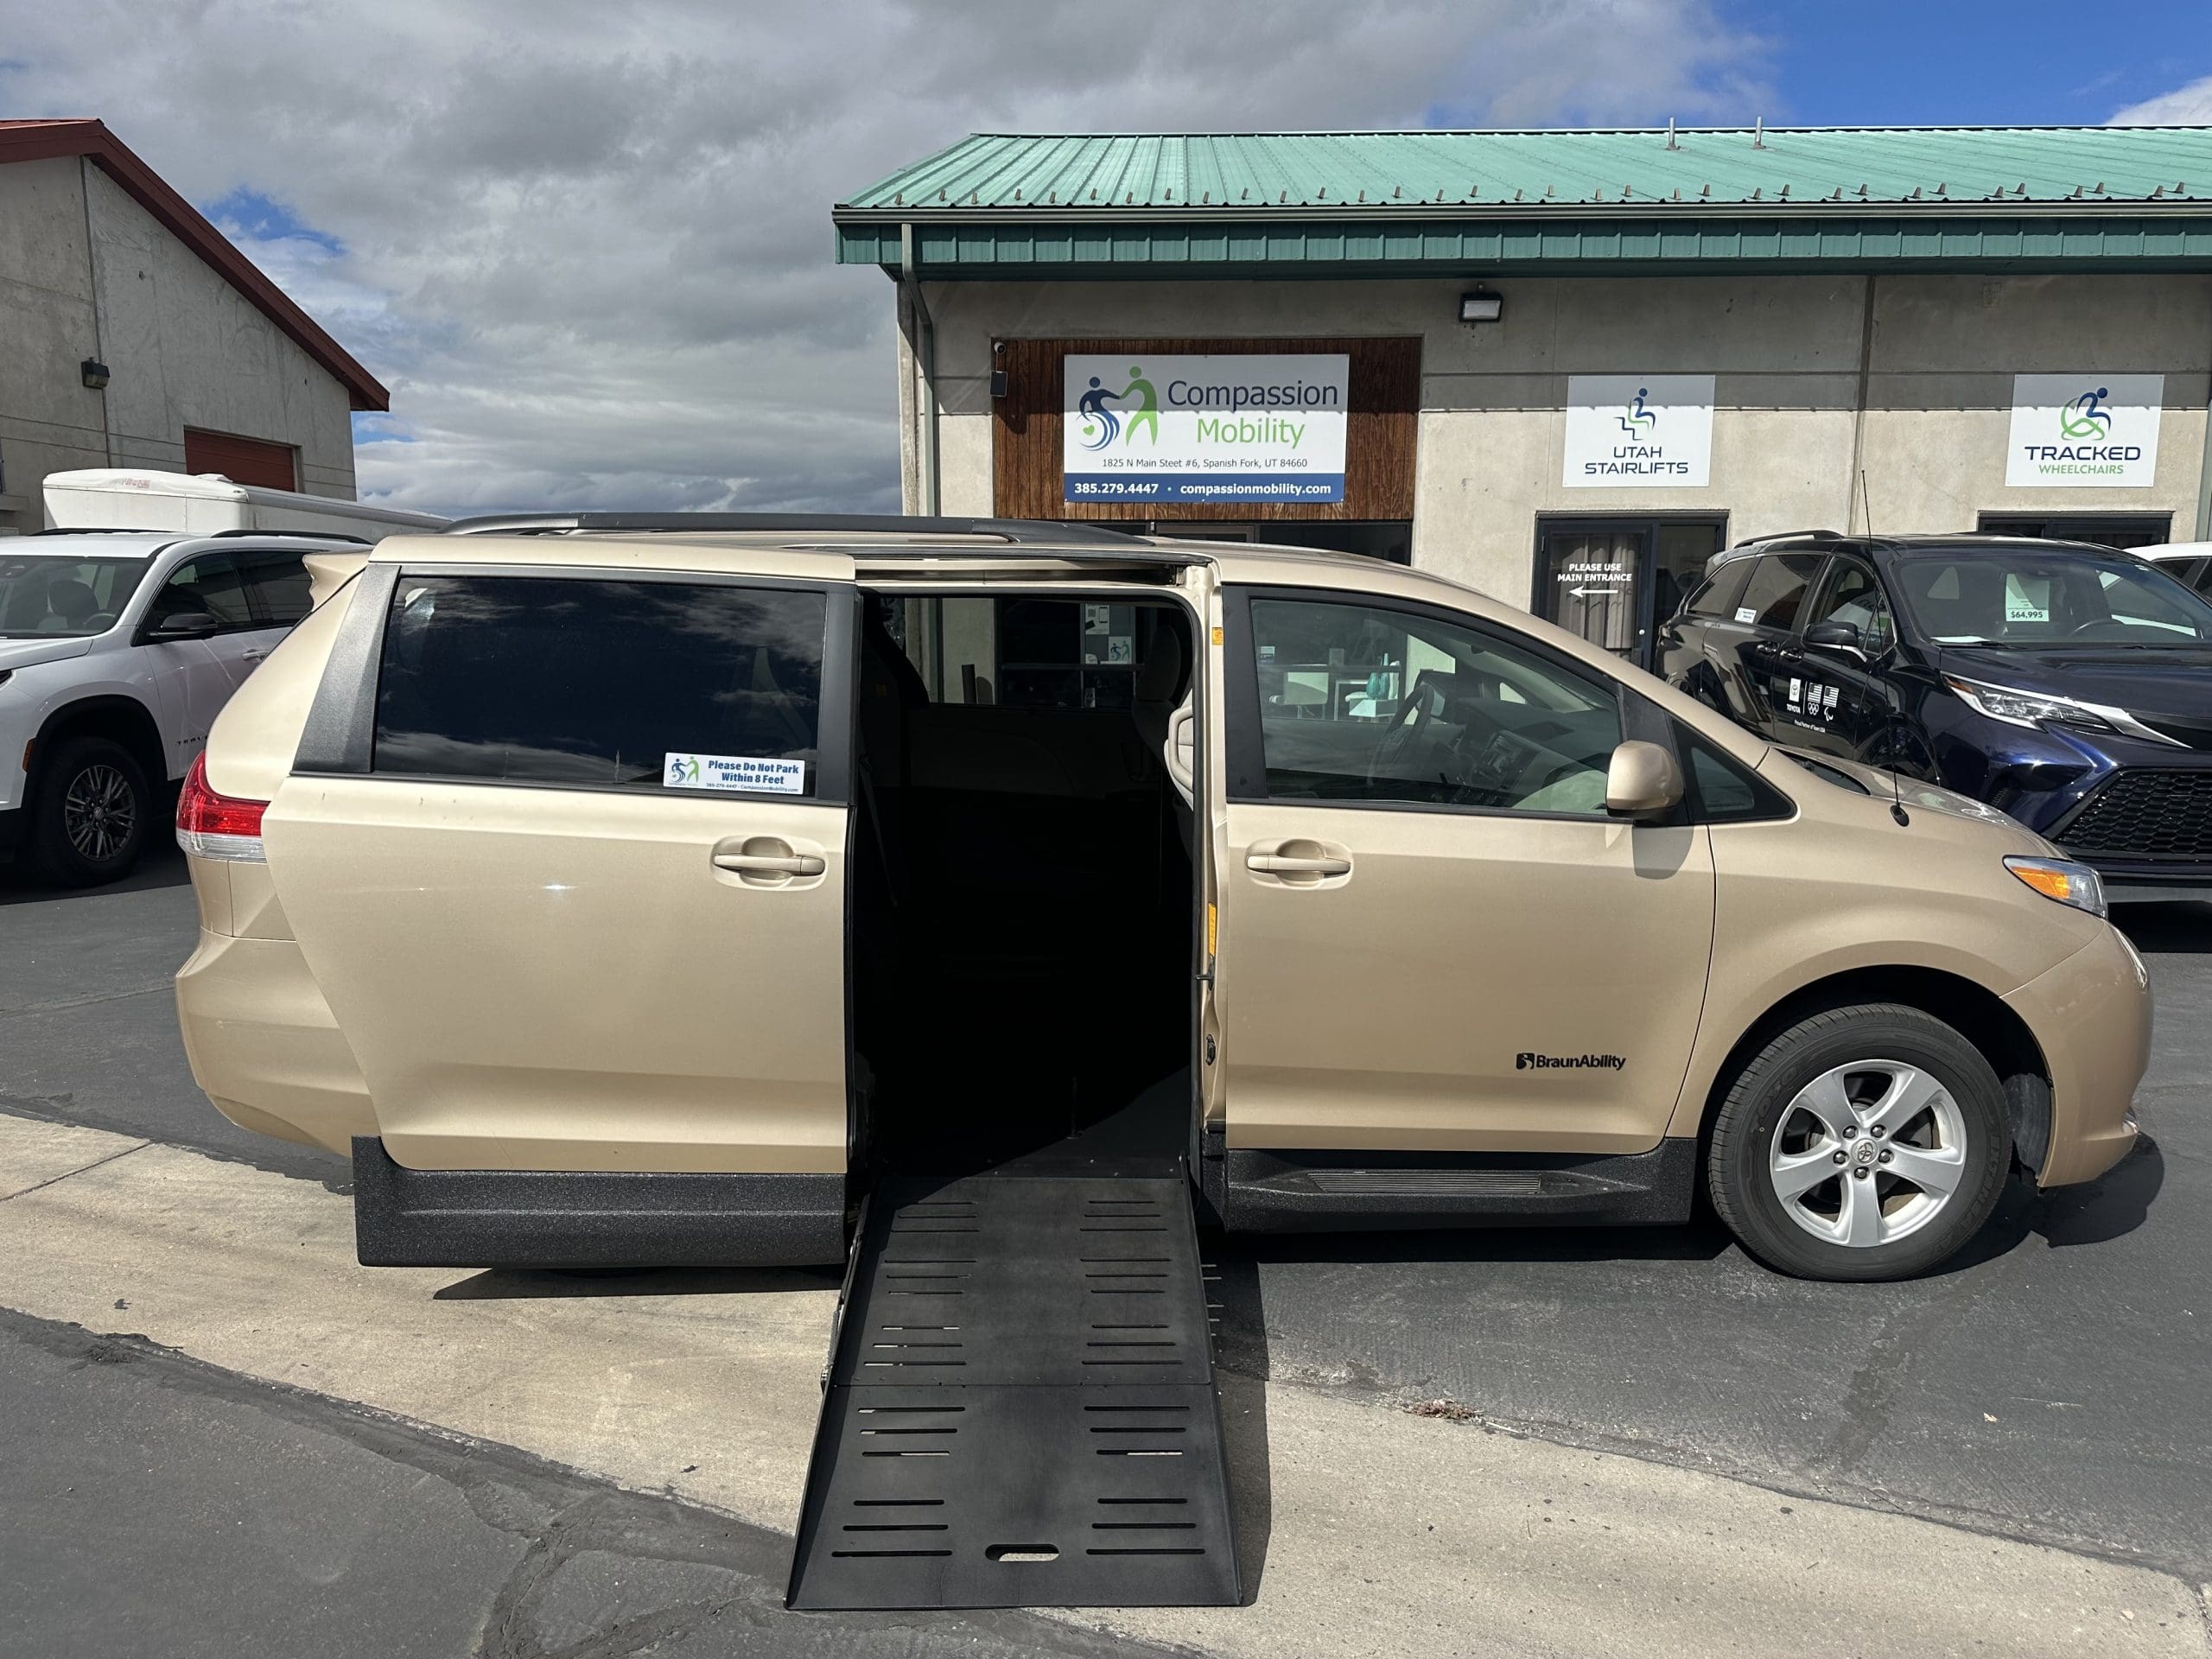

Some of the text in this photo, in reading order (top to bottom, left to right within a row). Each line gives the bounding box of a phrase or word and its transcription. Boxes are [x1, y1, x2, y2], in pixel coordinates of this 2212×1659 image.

[1168, 380, 1338, 411] Compassion
[1198, 418, 1306, 448] Mobility
[1613, 446, 1662, 458] UTAH
[2024, 446, 2141, 461] TRACKED
[1103, 458, 1307, 469] 1825 N Main Steet #6, Spanish Fork, UT 84660
[1585, 462, 1688, 474] STAIRLIFTS
[2039, 464, 2124, 474] WHEELCHAIRS
[1074, 482, 1332, 496] 385.279.4447 compassionmobility.com
[1568, 563, 1622, 572] PLEASE USE
[1585, 573, 1632, 582] ENTRANCE
[708, 760, 799, 774] Please Do Not Park
[721, 772, 785, 785] Within 8 Feet
[1535, 1054, 1626, 1071] BraunAbility
